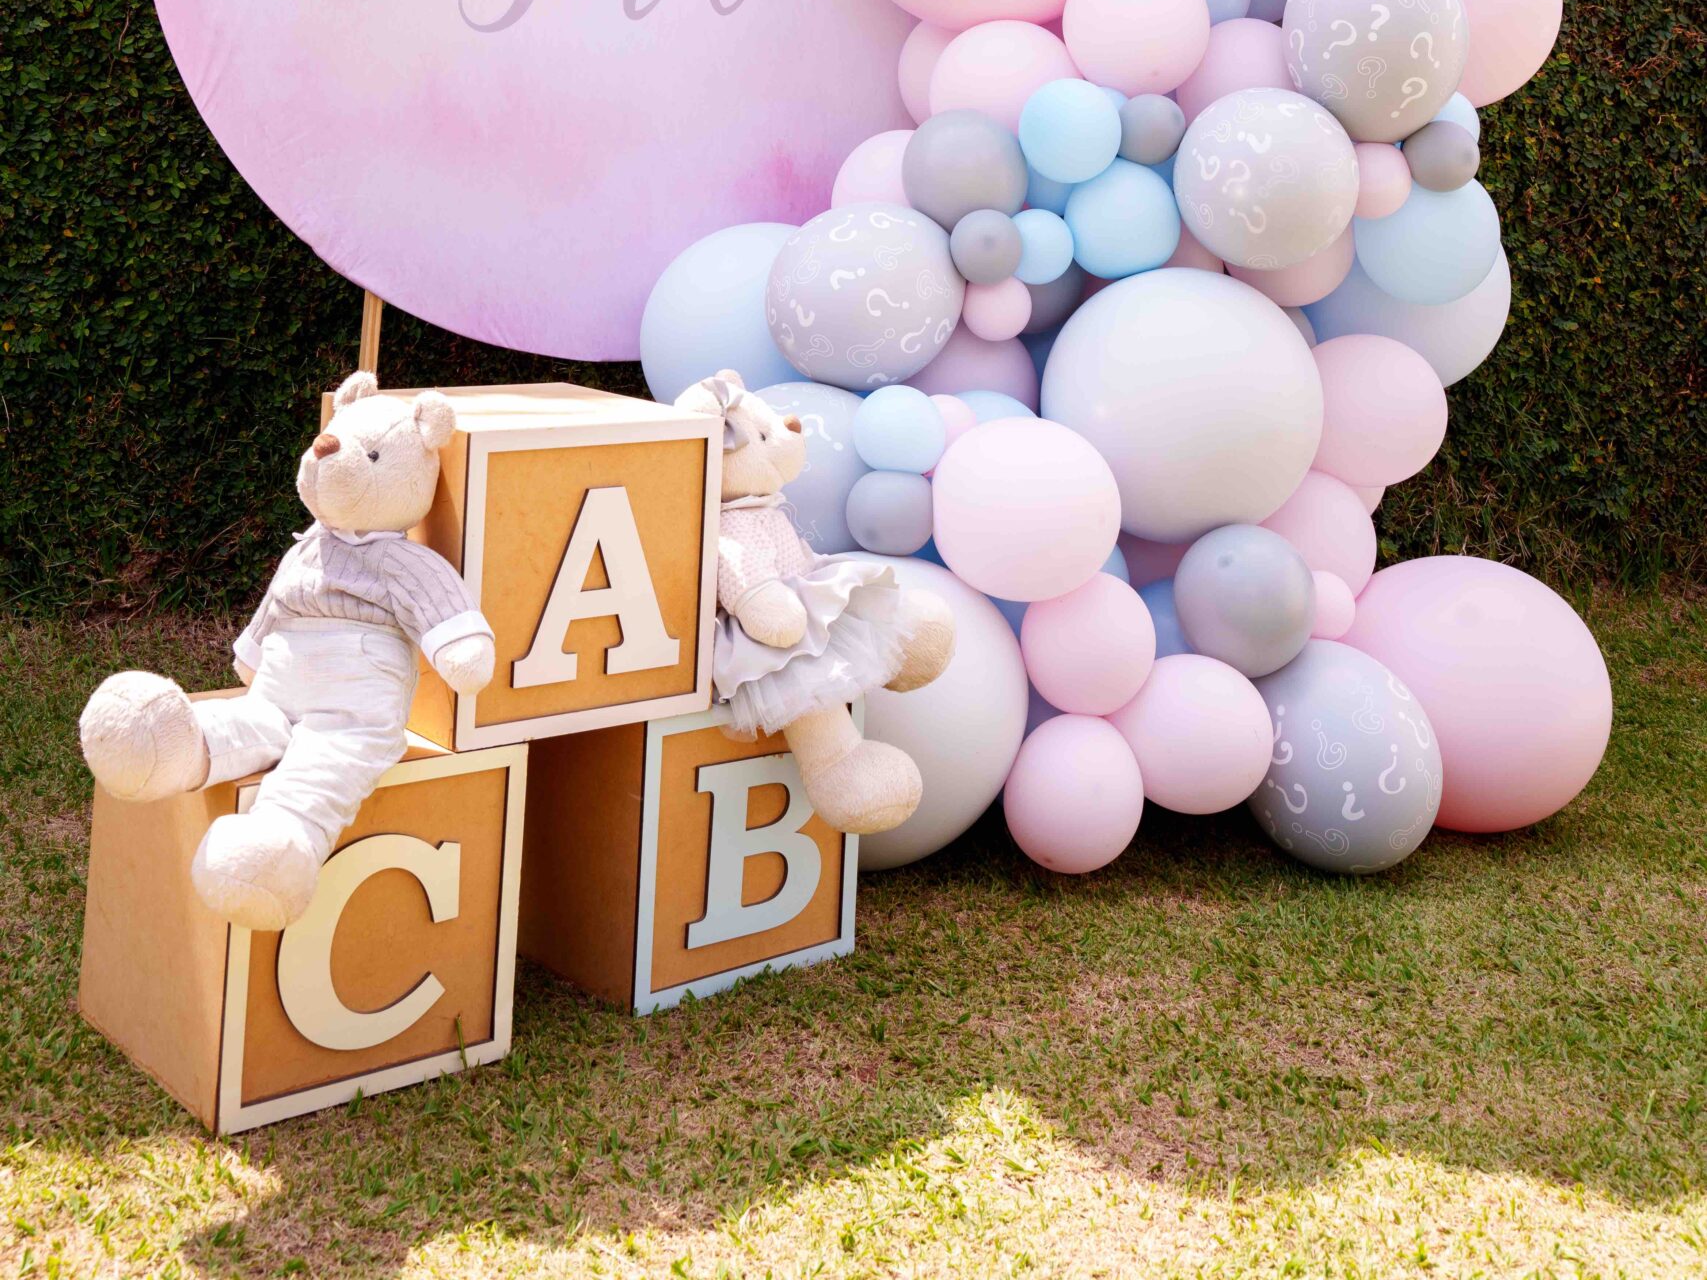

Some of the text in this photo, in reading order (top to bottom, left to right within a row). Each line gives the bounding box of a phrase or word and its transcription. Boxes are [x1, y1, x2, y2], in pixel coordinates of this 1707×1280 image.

[511, 485, 681, 689] A
[276, 832, 461, 1051] C
[684, 752, 823, 951] B
